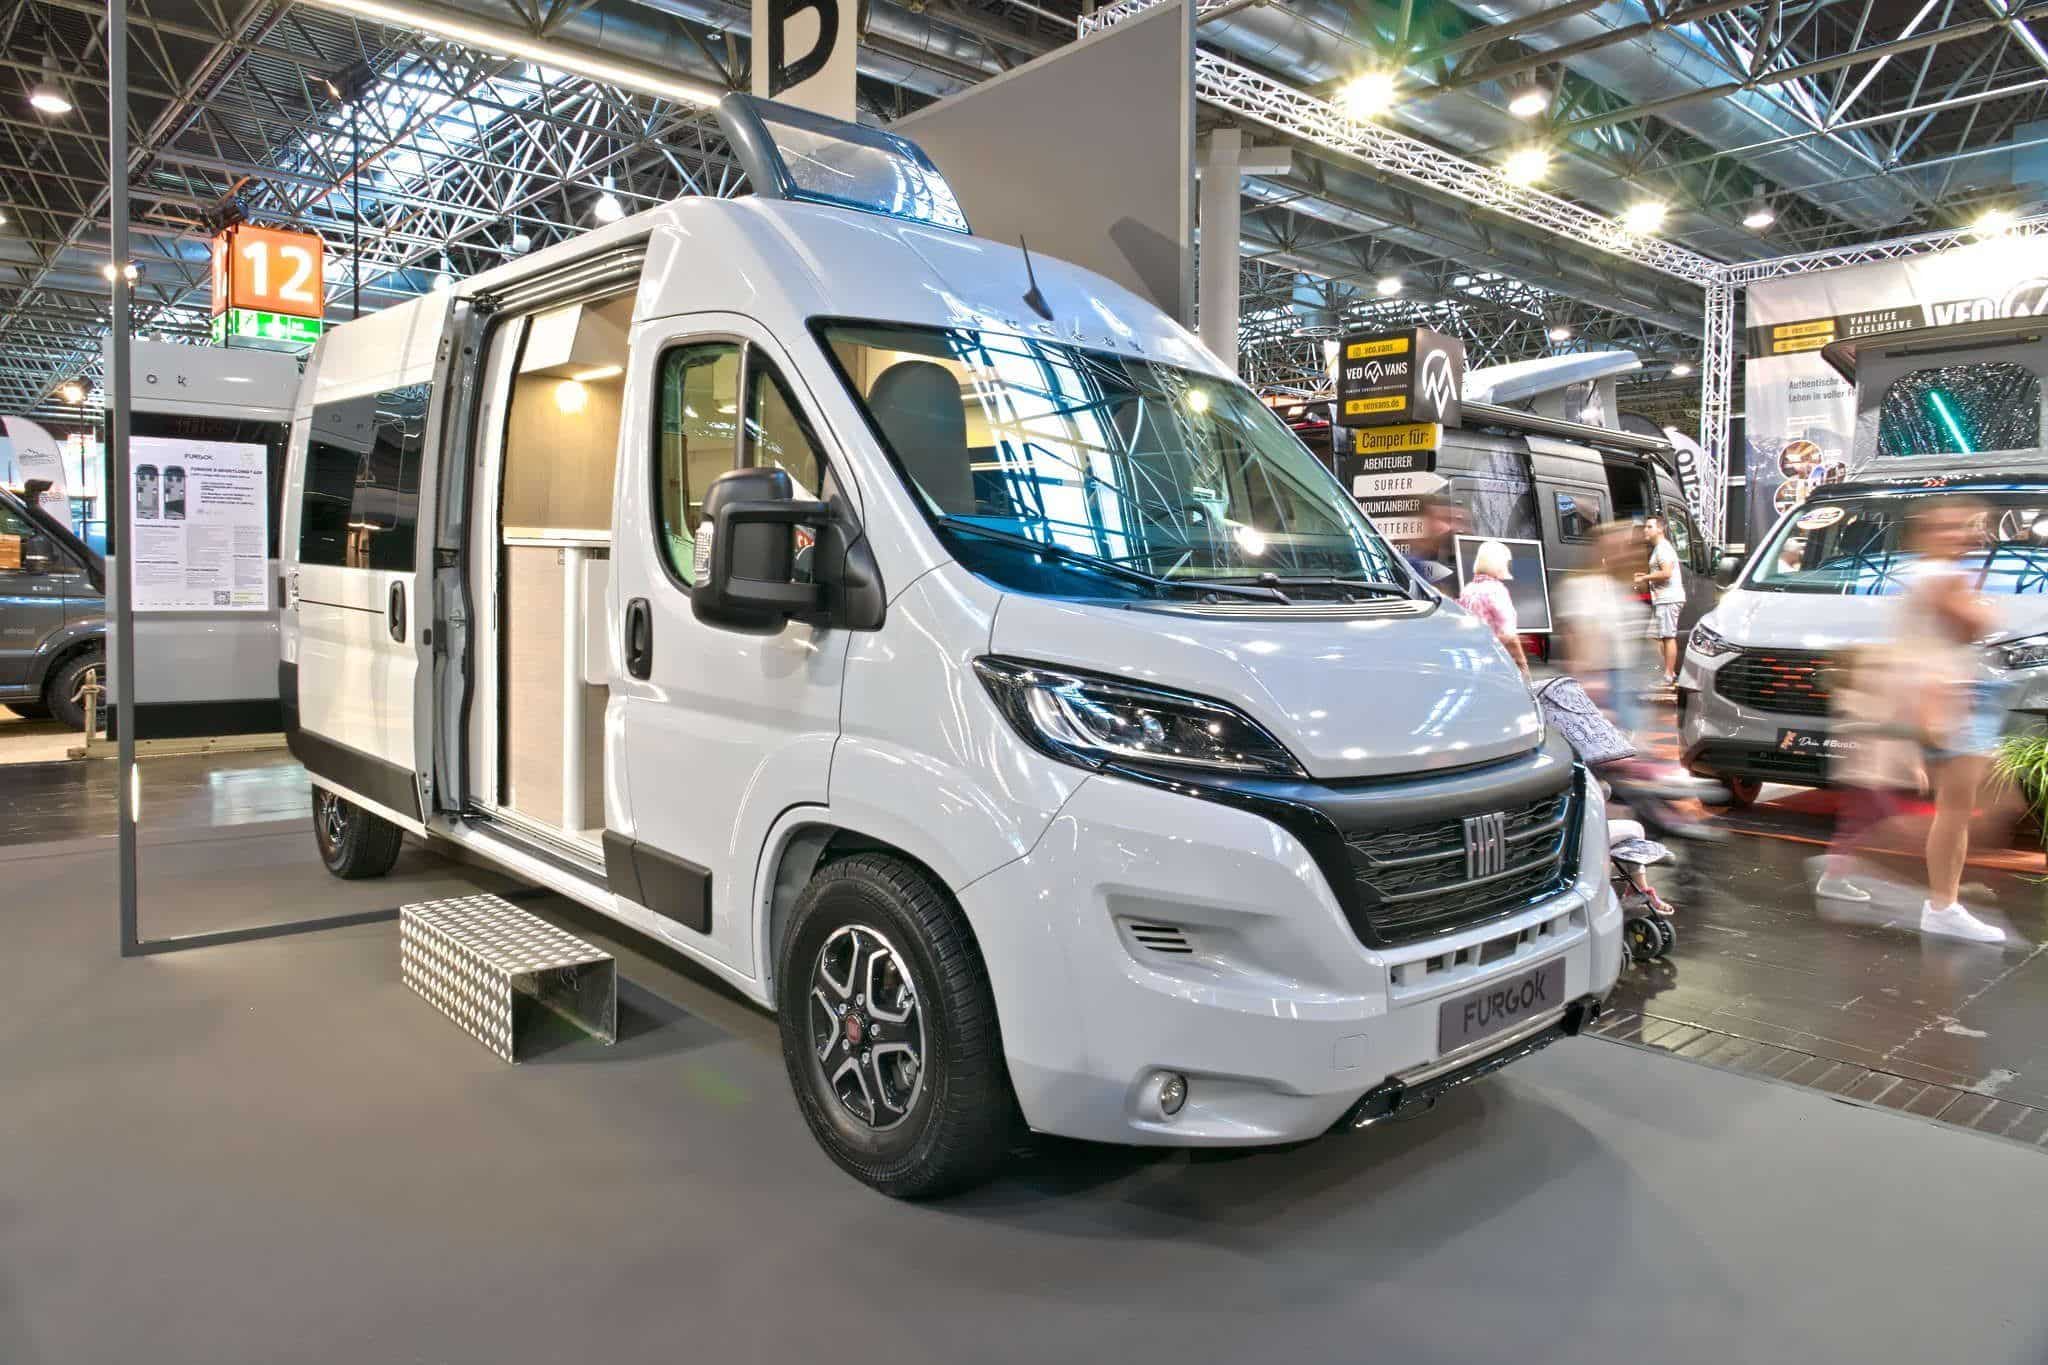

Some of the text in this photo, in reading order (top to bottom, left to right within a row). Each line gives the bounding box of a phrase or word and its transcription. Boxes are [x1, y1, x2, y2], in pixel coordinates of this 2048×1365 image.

[242, 241, 314, 303] 12
[1850, 311, 1897, 325] VANLIFE
[1849, 319, 1913, 335] EXCLUSIVE
[1346, 361, 1408, 380] VEO VANS
[1362, 428, 1430, 449] Camper für:
[1363, 455, 1413, 470] ABENTEURER
[1374, 478, 1413, 491] SURFER
[1358, 499, 1421, 514] MOUNTAINBIKER
[1463, 971, 1546, 1033] FURGOK
